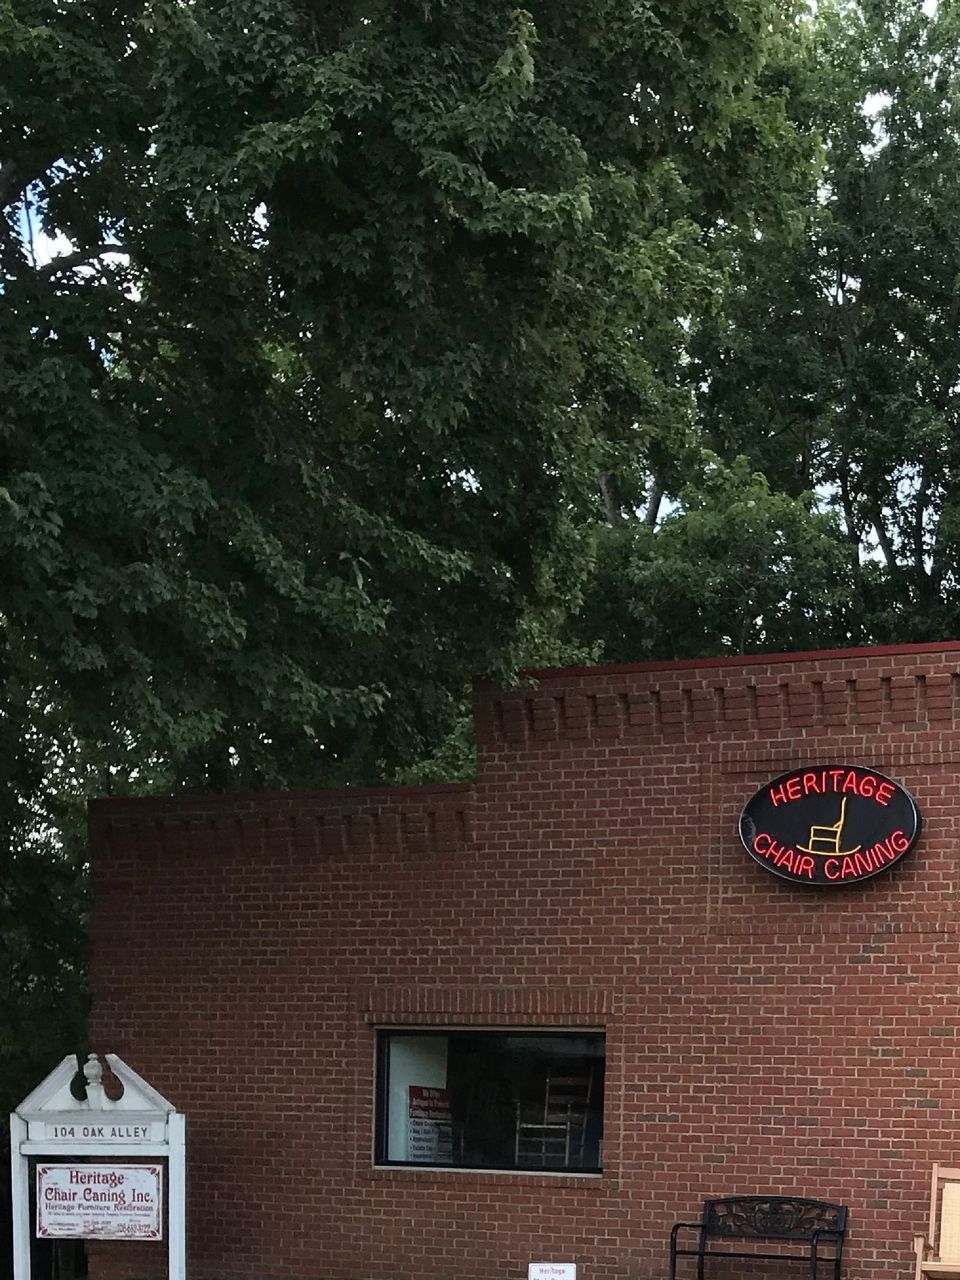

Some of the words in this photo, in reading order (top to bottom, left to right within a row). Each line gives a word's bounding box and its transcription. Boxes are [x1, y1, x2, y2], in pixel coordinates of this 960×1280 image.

[769, 770, 896, 807] HERITAGE
[753, 832, 816, 879] CHAIR
[824, 830, 910, 880] CANING
[54, 1127, 75, 1138] 104
[82, 1127, 104, 1138] OAK
[111, 1127, 148, 1138] ALLEY
[69, 1170, 125, 1188] Heritage
[44, 1187, 78, 1202] Chair
[83, 1187, 126, 1206] Caning
[131, 1188, 154, 1203] Inc.
[45, 1203, 75, 1212] Heritage
[77, 1203, 111, 1212] Furniture
